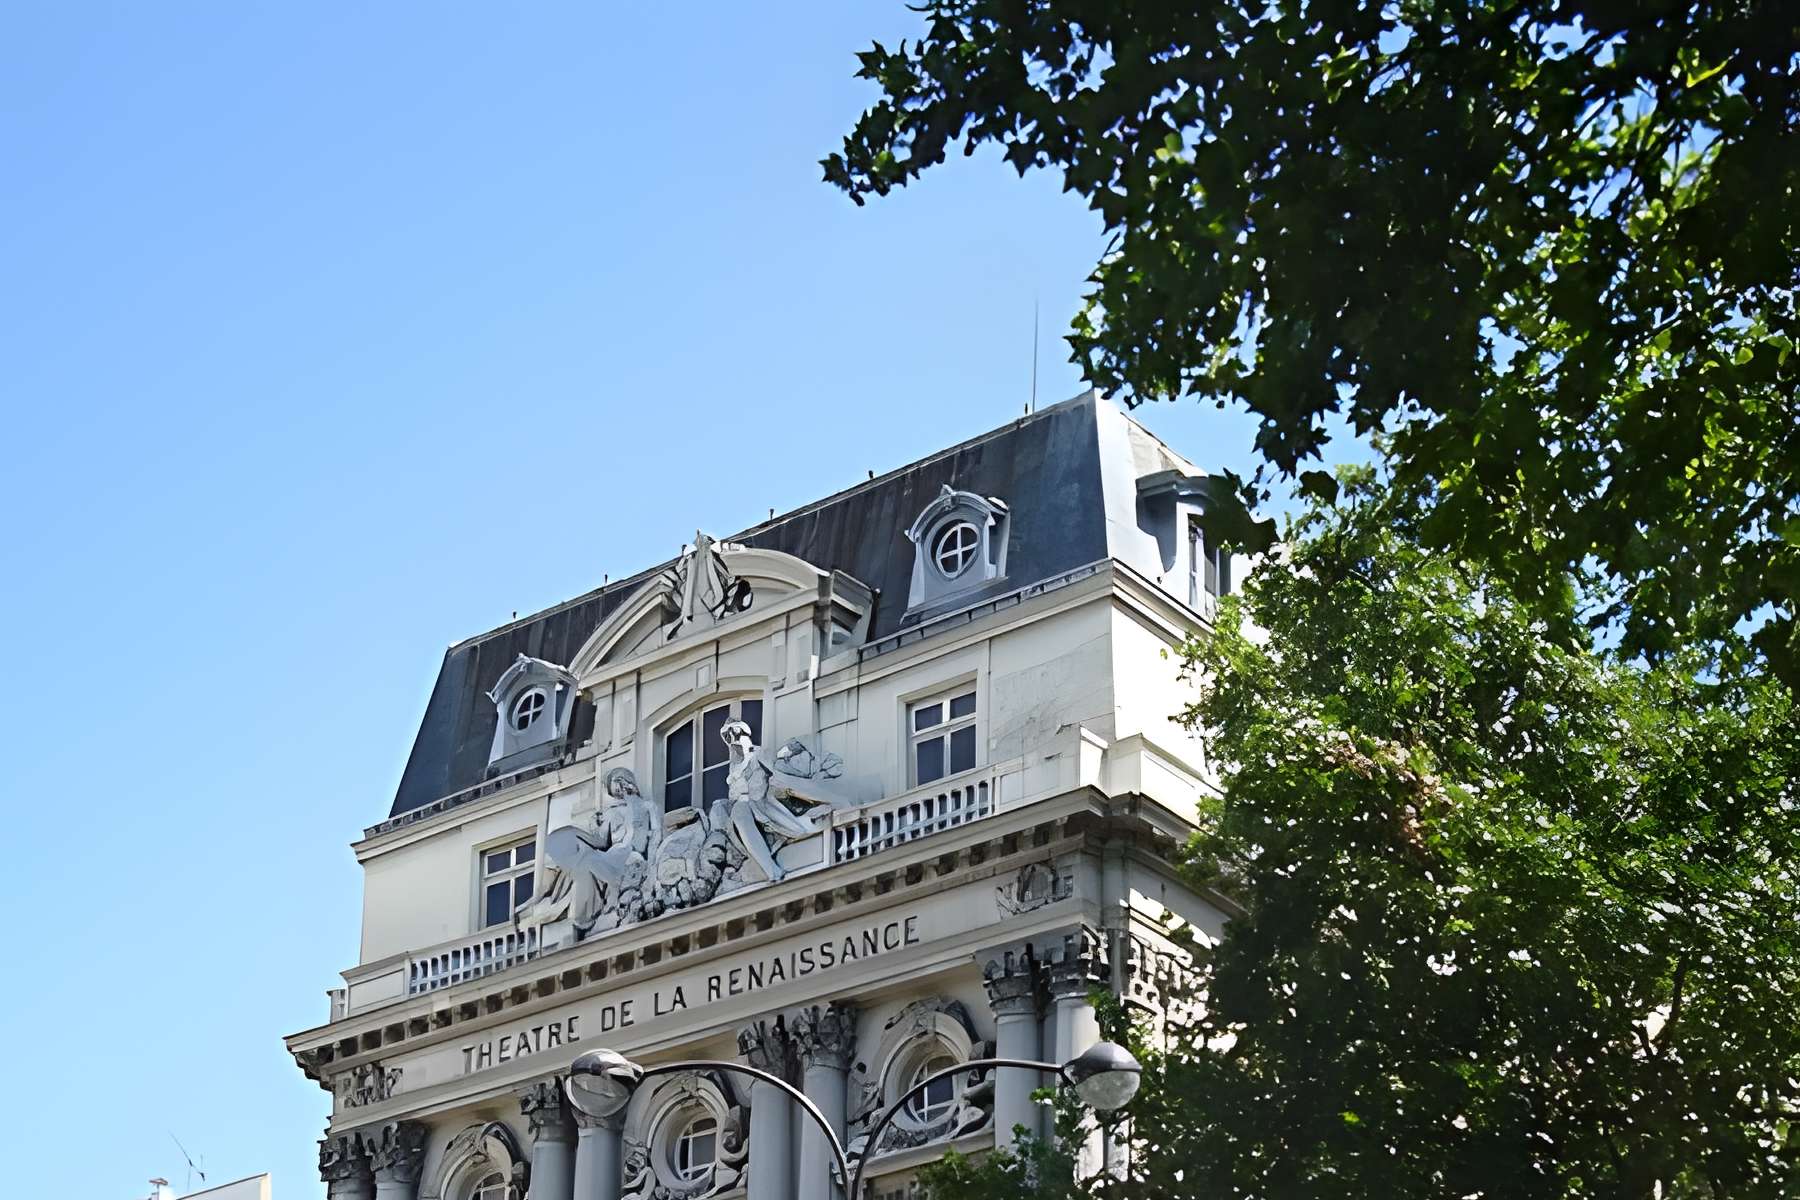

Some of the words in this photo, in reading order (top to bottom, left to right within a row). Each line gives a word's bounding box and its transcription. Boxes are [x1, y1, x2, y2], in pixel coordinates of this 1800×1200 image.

[462, 1015, 581, 1075] THEATRE
[601, 1000, 634, 1032] DE
[654, 986, 687, 1016] LA
[708, 915, 920, 1002] RENAISSANCE
